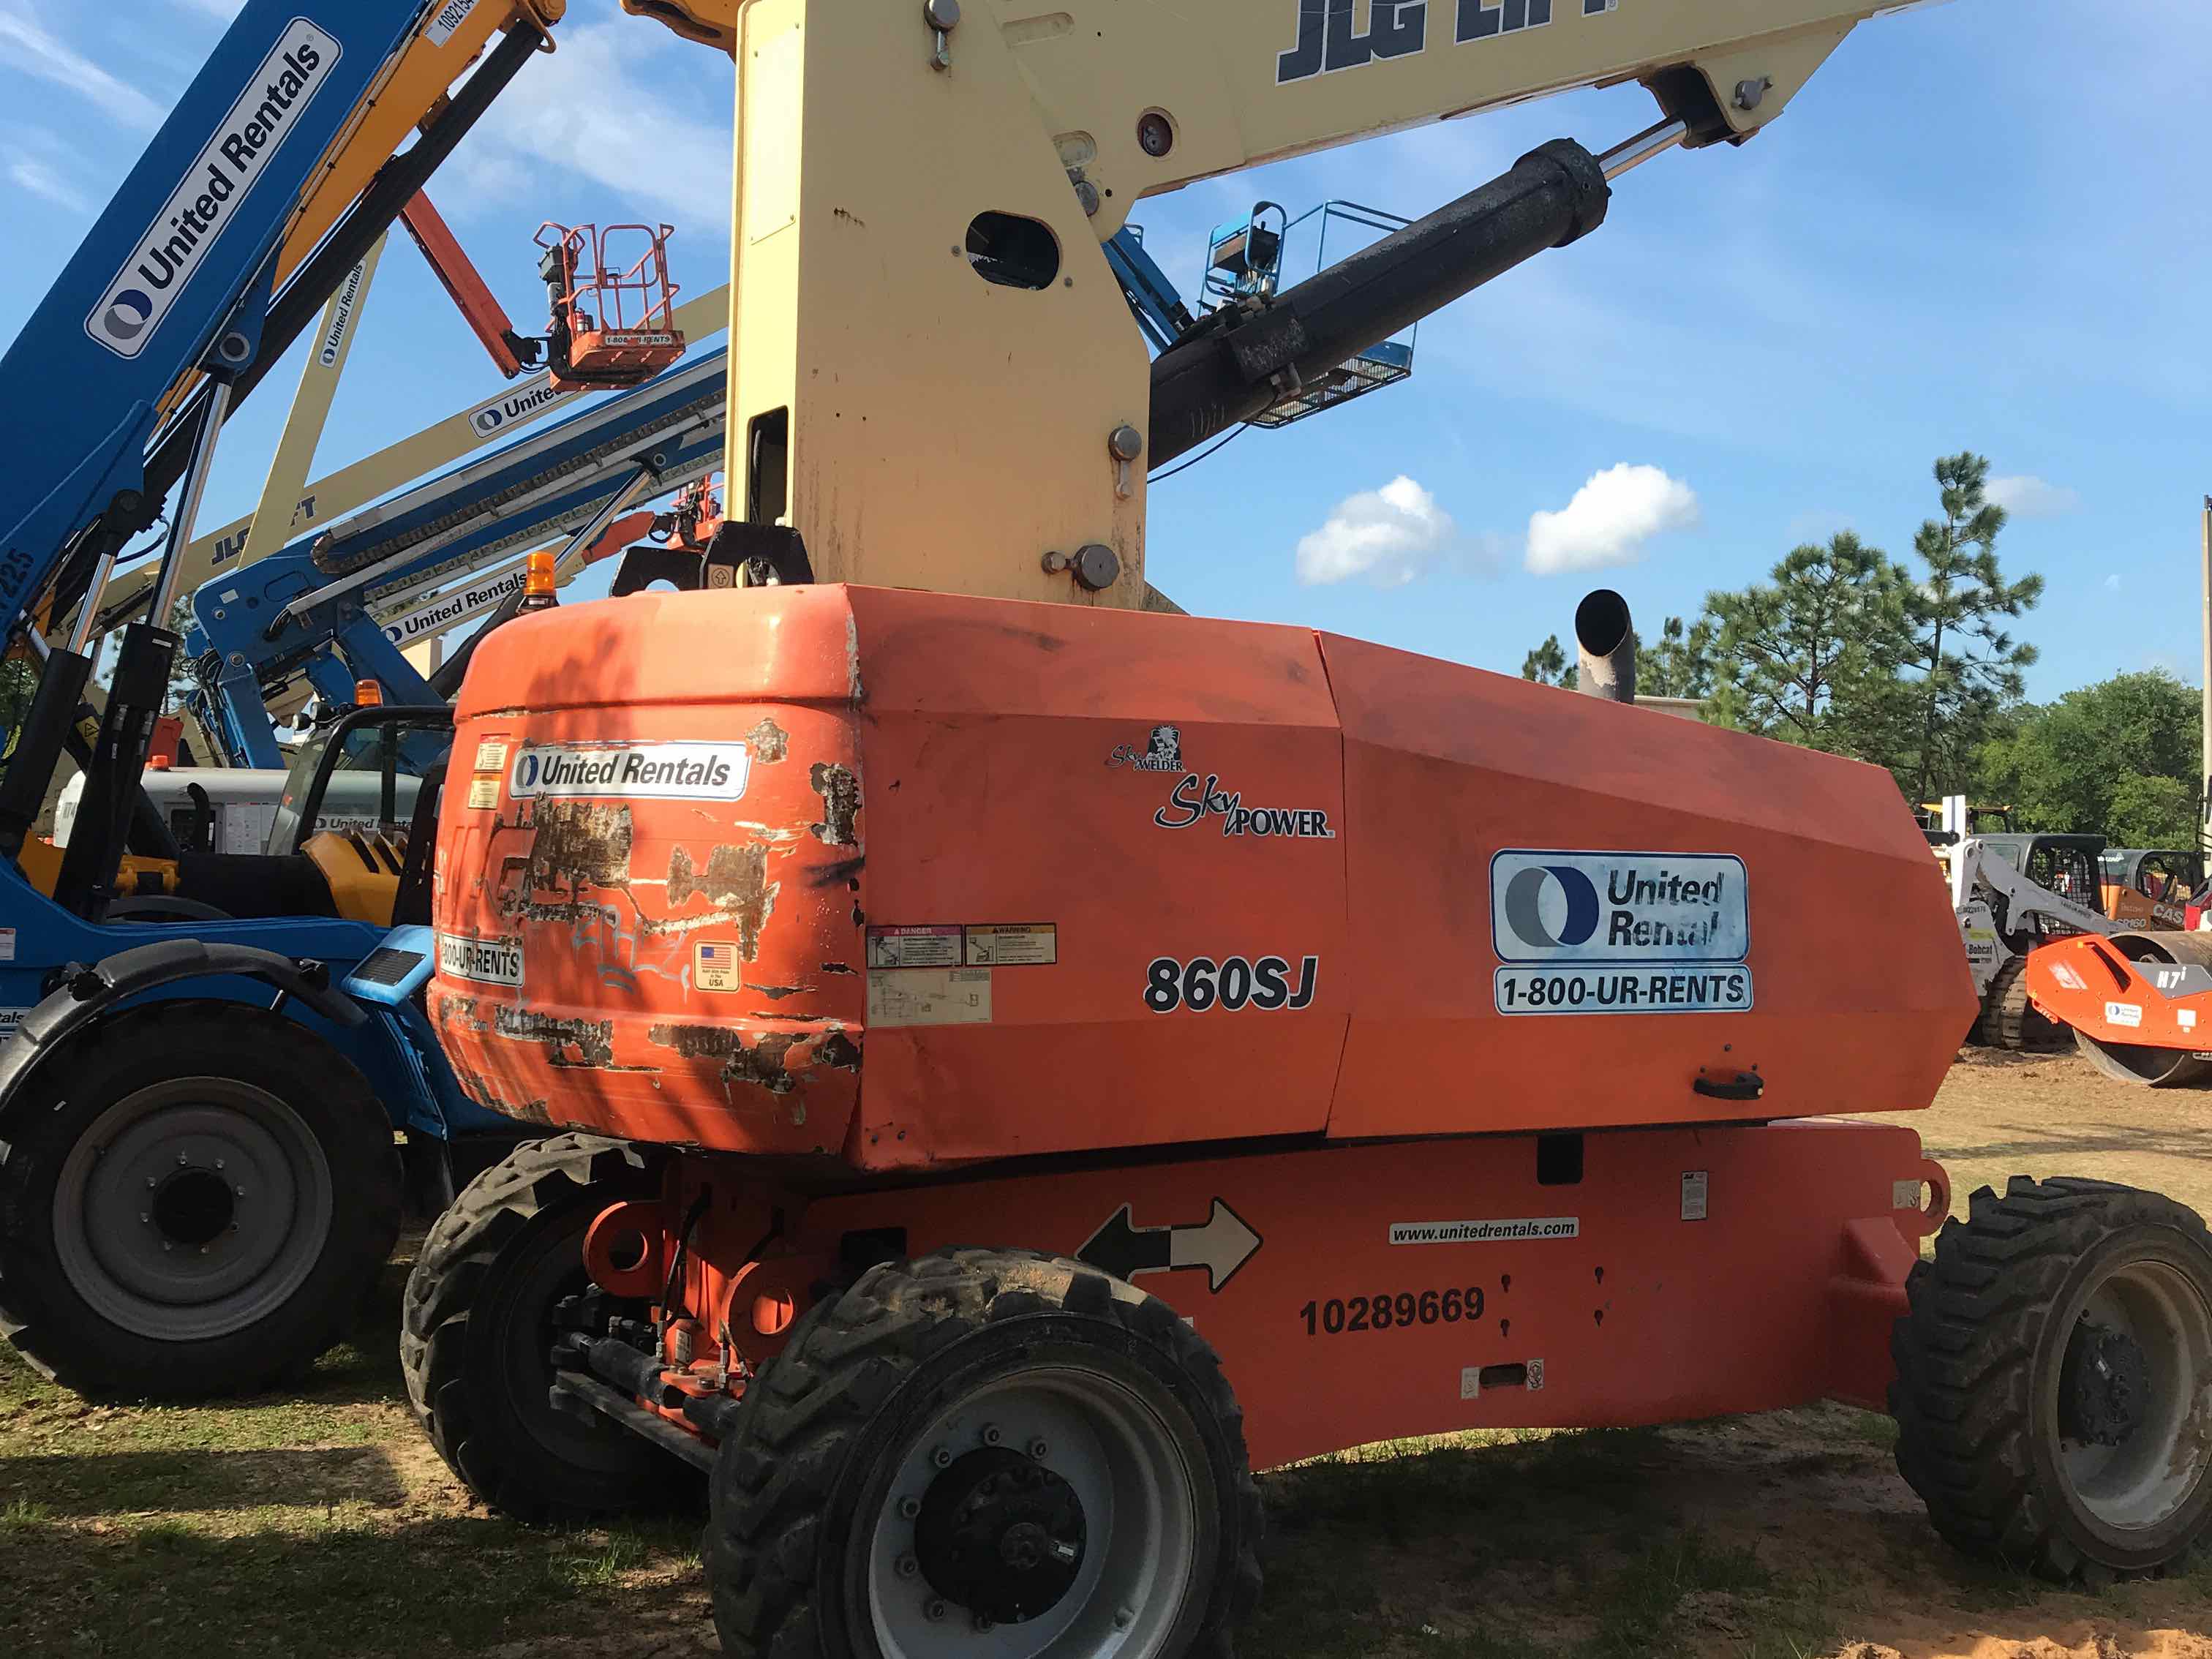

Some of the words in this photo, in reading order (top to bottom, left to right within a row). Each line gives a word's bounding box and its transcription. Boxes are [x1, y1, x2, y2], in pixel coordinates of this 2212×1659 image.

[138, 163, 235, 290] United
[220, 44, 320, 174] Rentals
[328, 306, 348, 347] United
[341, 263, 363, 306] Rentals
[504, 388, 563, 418] Unite
[405, 598, 463, 634] United
[466, 573, 527, 608] Rentals
[542, 753, 618, 785] United
[621, 753, 731, 786] Rentals
[1136, 760, 1183, 771] WELDER
[1155, 773, 1241, 836] Sky
[1235, 808, 1328, 837] POWER
[1608, 870, 1725, 906] United
[709, 979, 723, 987] USA
[1143, 955, 1319, 1013] 860SJ
[1503, 975, 1745, 1006] 1-800-UR-RENTS
[1393, 1220, 1576, 1242] www.unitedrentals.com
[1301, 1286, 1485, 1335] 10289669
